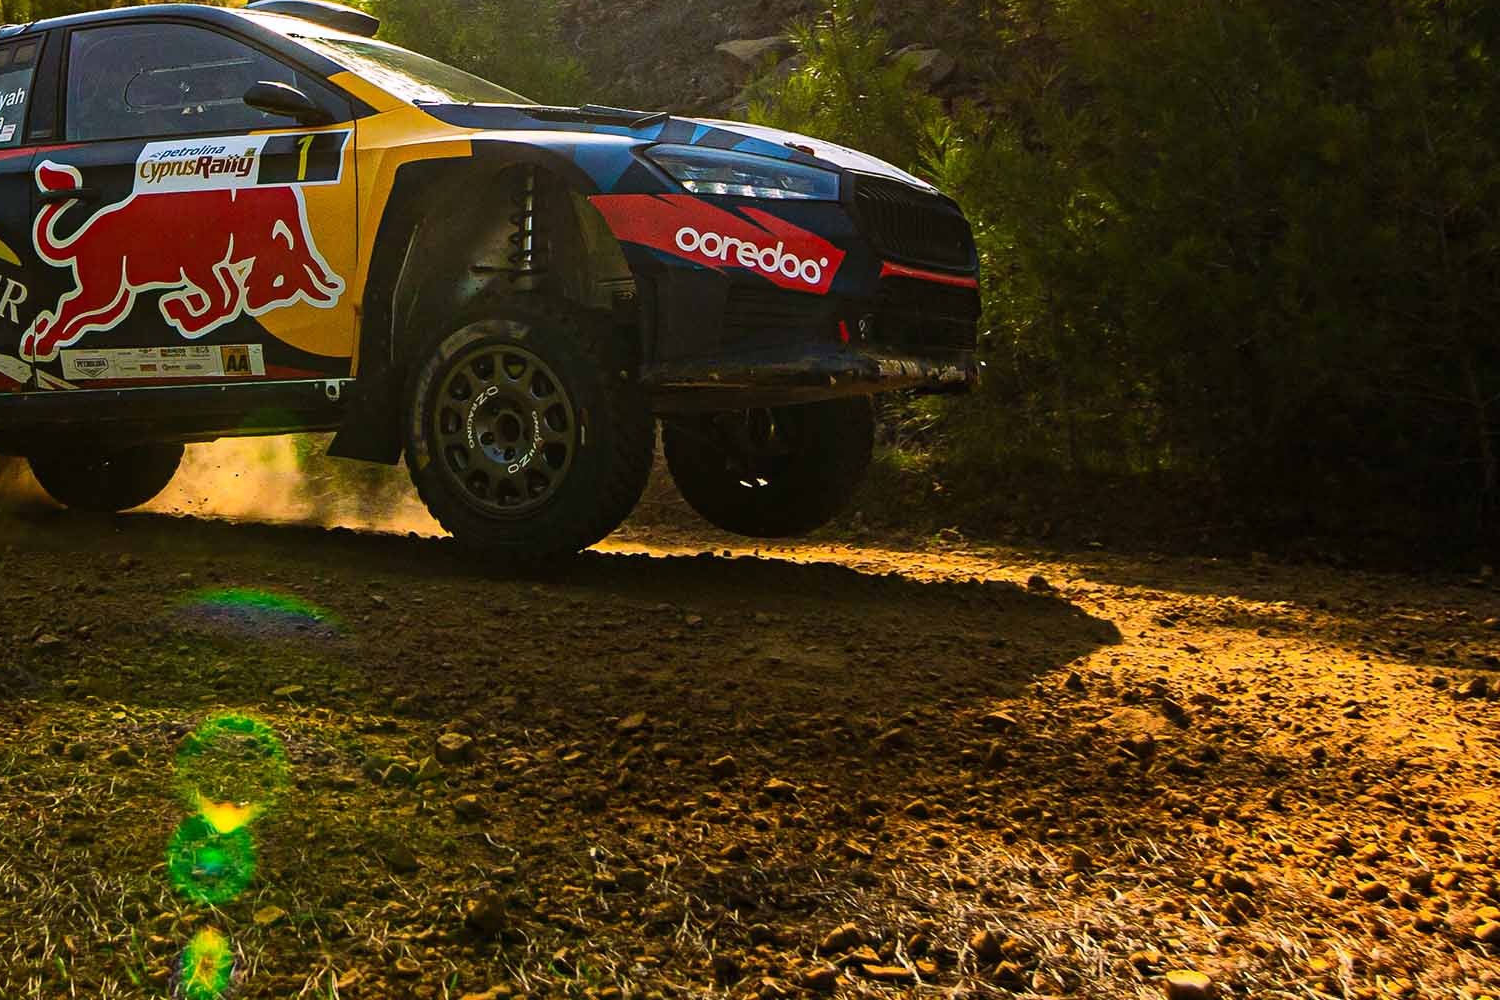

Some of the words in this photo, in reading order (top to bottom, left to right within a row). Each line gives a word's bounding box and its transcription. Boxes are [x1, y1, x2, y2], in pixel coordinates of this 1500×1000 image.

[159, 145, 226, 160] petrolina
[297, 135, 315, 181] 1
[675, 226, 822, 285] ooredoo
[227, 354, 248, 372] AA
